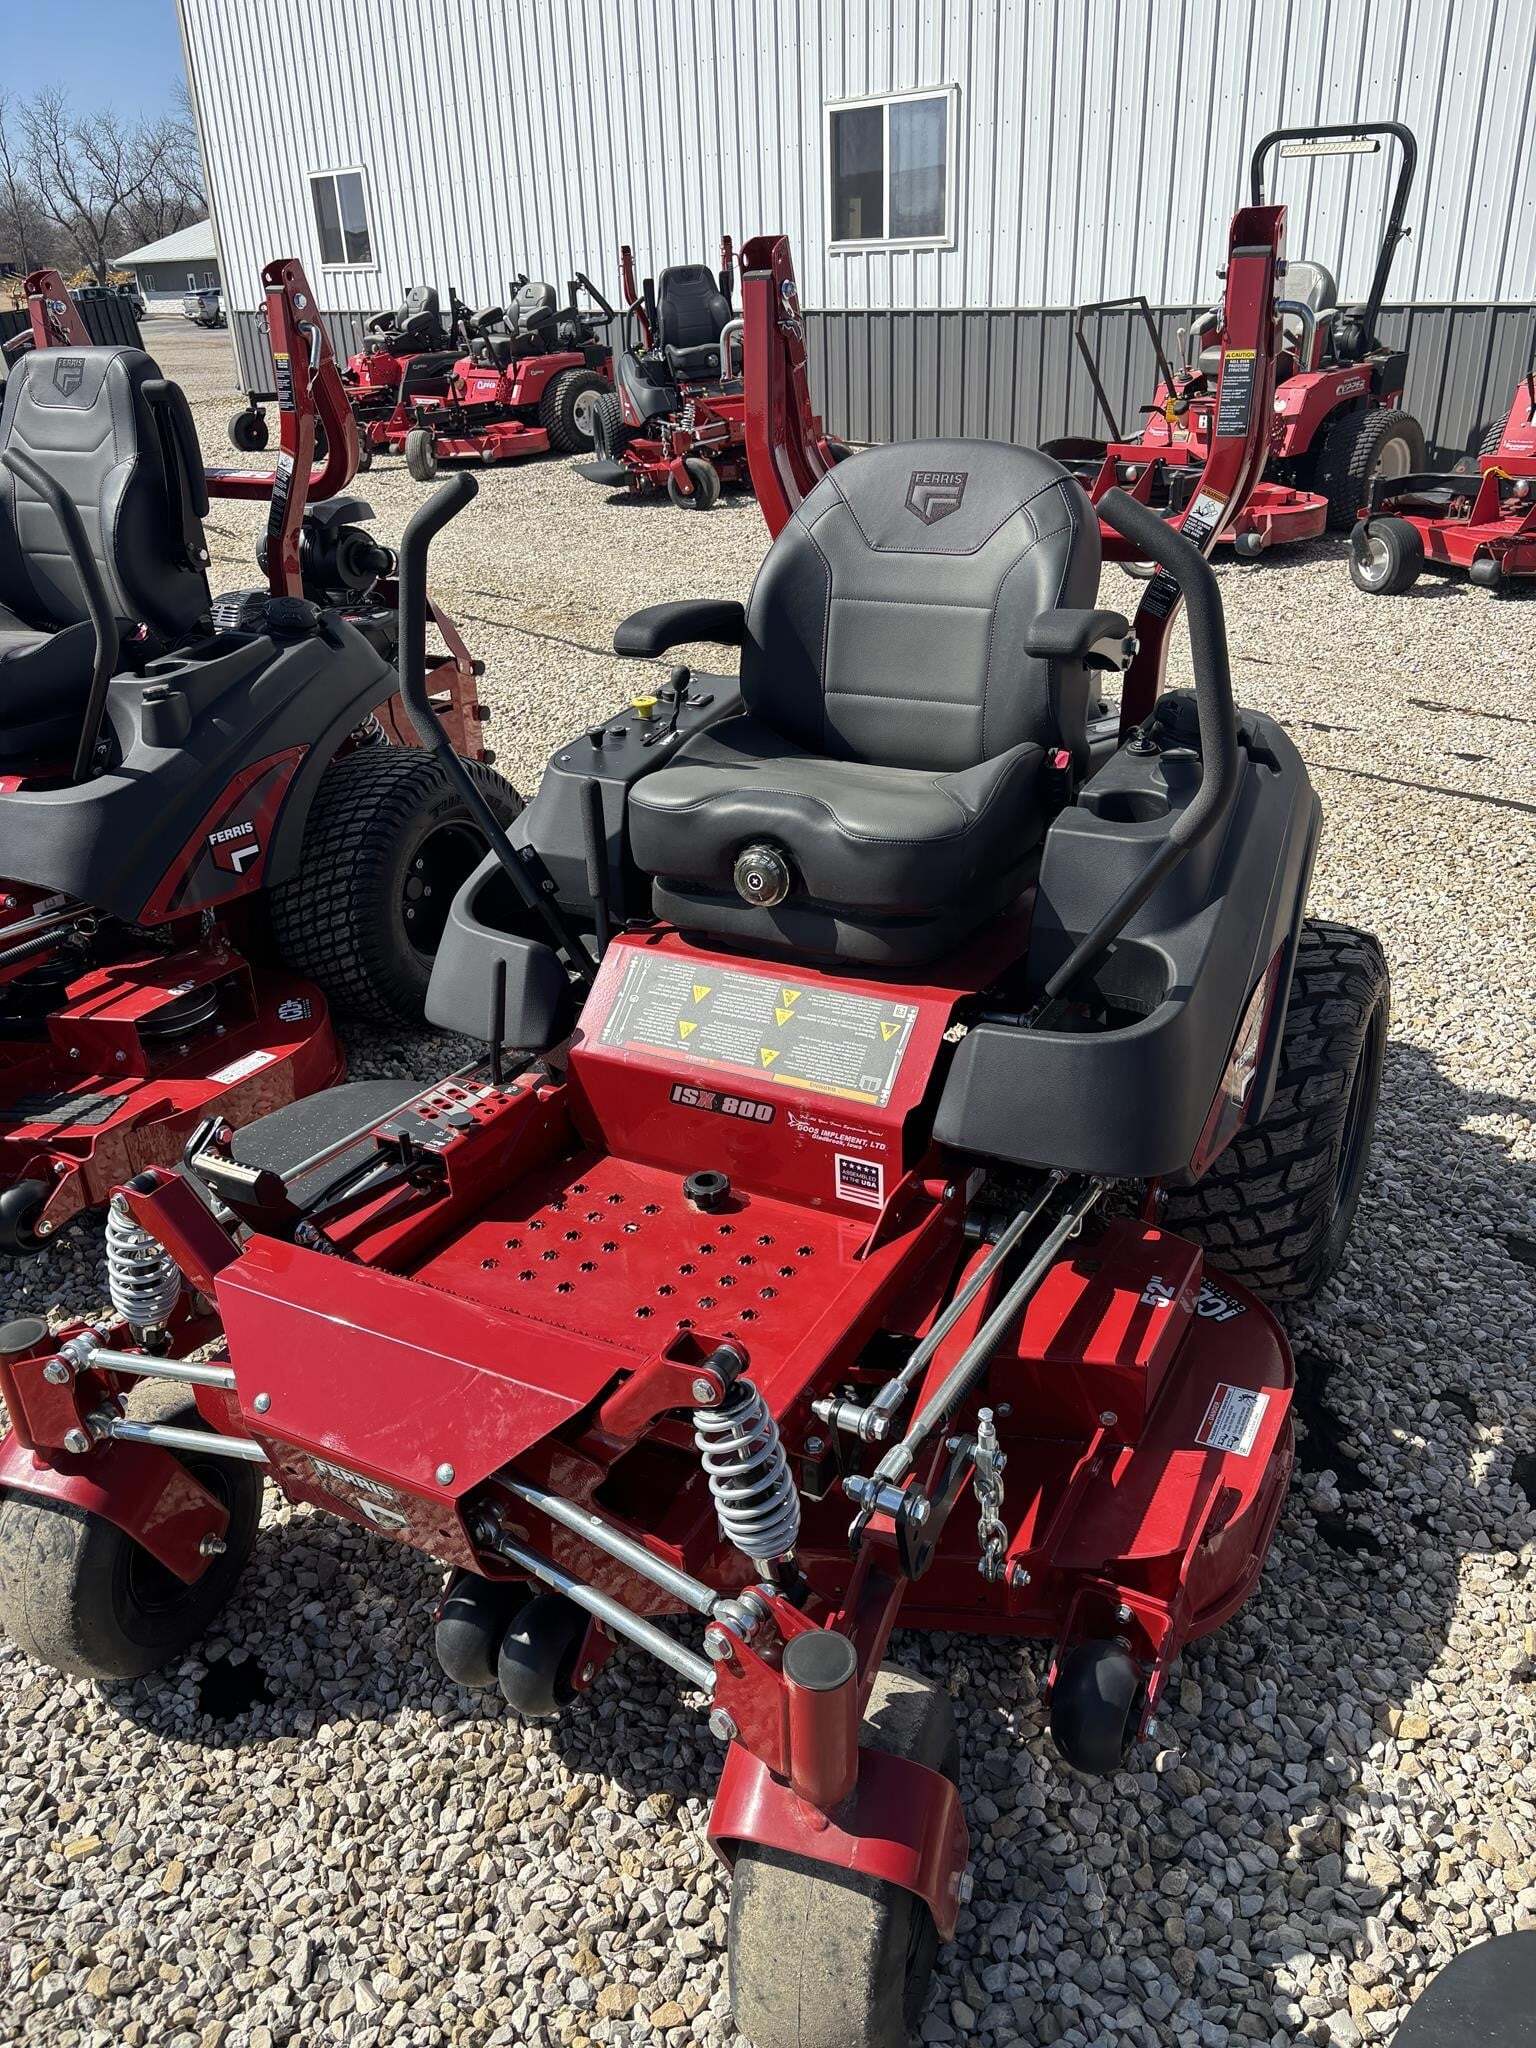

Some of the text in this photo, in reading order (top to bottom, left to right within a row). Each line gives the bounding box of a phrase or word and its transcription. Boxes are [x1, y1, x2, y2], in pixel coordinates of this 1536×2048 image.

[915, 473, 962, 484] FERRIS
[209, 822, 254, 845] FERRIS
[671, 1086, 773, 1123] ISX 800
[796, 1124, 819, 1135] GOOS
[820, 1129, 868, 1147] IMPLEMENT,
[846, 1140, 863, 1150] Iowa
[841, 1169, 877, 1183] ASSEMBLED
[860, 1179, 876, 1189] USA
[1140, 1275, 1176, 1308] 52"
[314, 1459, 394, 1501] FERRIS
